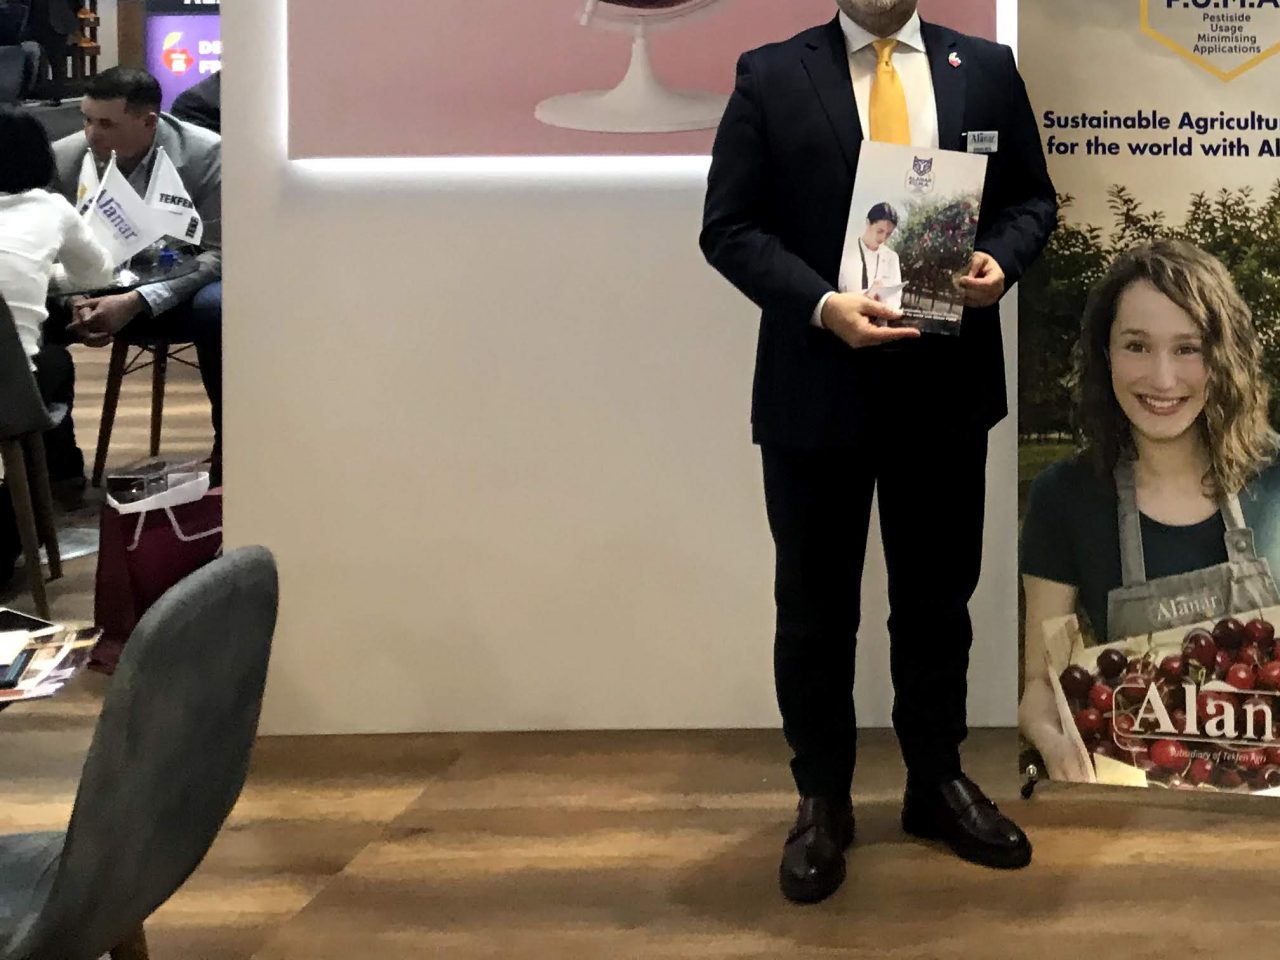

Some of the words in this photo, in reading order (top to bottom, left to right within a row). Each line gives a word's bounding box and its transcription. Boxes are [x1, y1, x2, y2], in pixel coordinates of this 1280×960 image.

[1202, 12, 1251, 22] Pestiside
[1210, 23, 1243, 35] Usage
[1197, 33, 1257, 45] Minimising
[1193, 44, 1261, 55] Applications
[1042, 110, 1171, 131] Sustainable
[1046, 136, 1079, 156] for
[1086, 136, 1121, 156] the
[1128, 136, 1193, 157] world
[1201, 138, 1250, 158] with
[1156, 591, 1218, 622] Alanar
